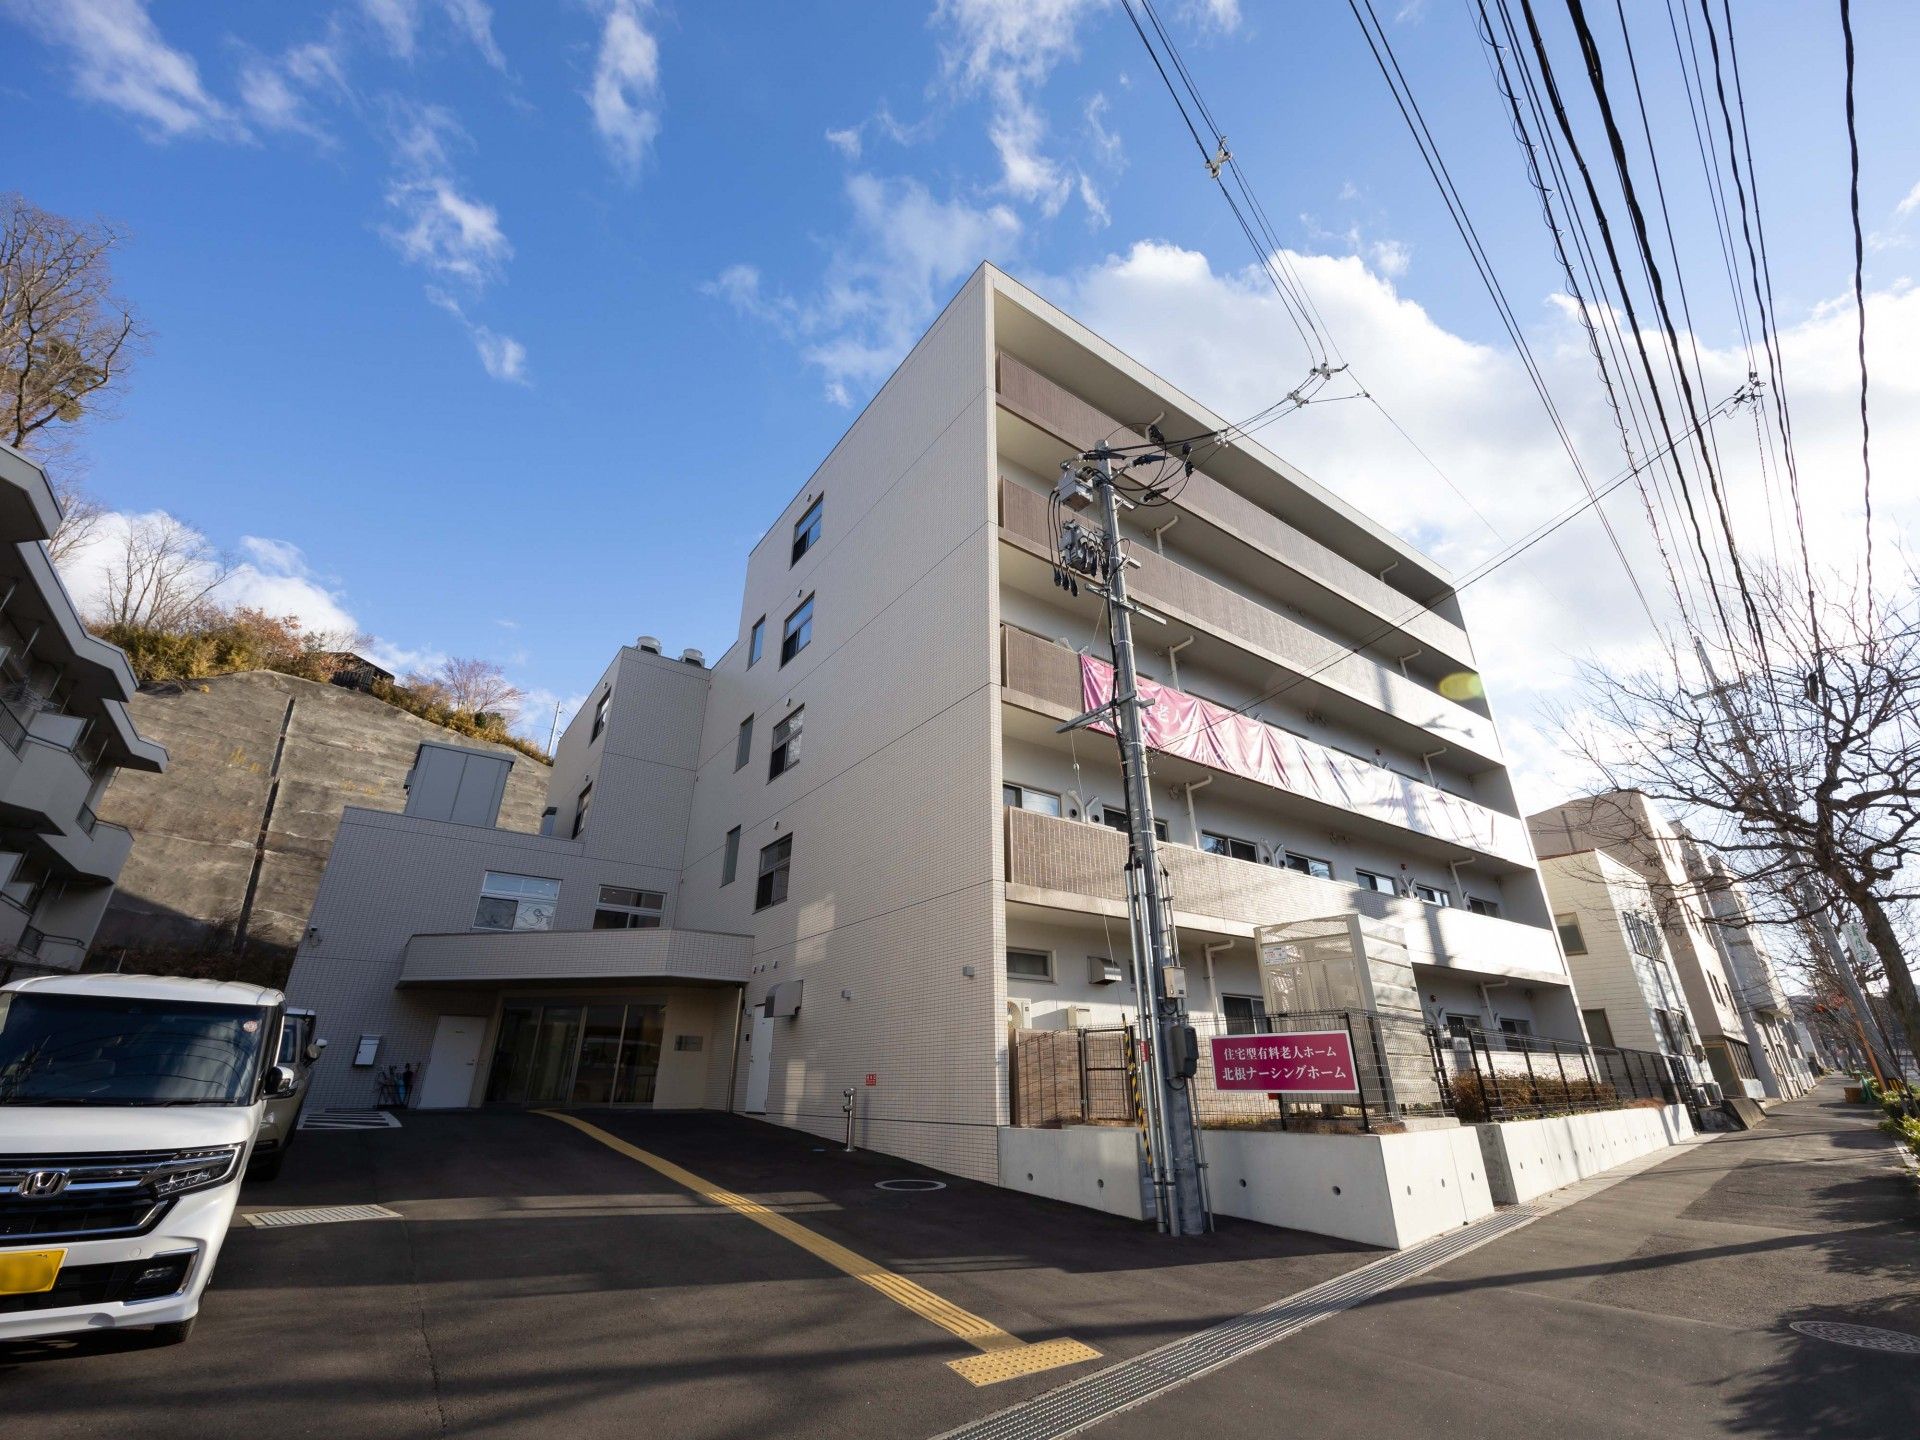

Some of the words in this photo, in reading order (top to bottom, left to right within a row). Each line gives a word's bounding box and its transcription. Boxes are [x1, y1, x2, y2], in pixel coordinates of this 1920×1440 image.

[1223, 1045, 1337, 1060] 住宅型有料老人ホーム
[1222, 1064, 1347, 1081] 北根ナーシングホーム
